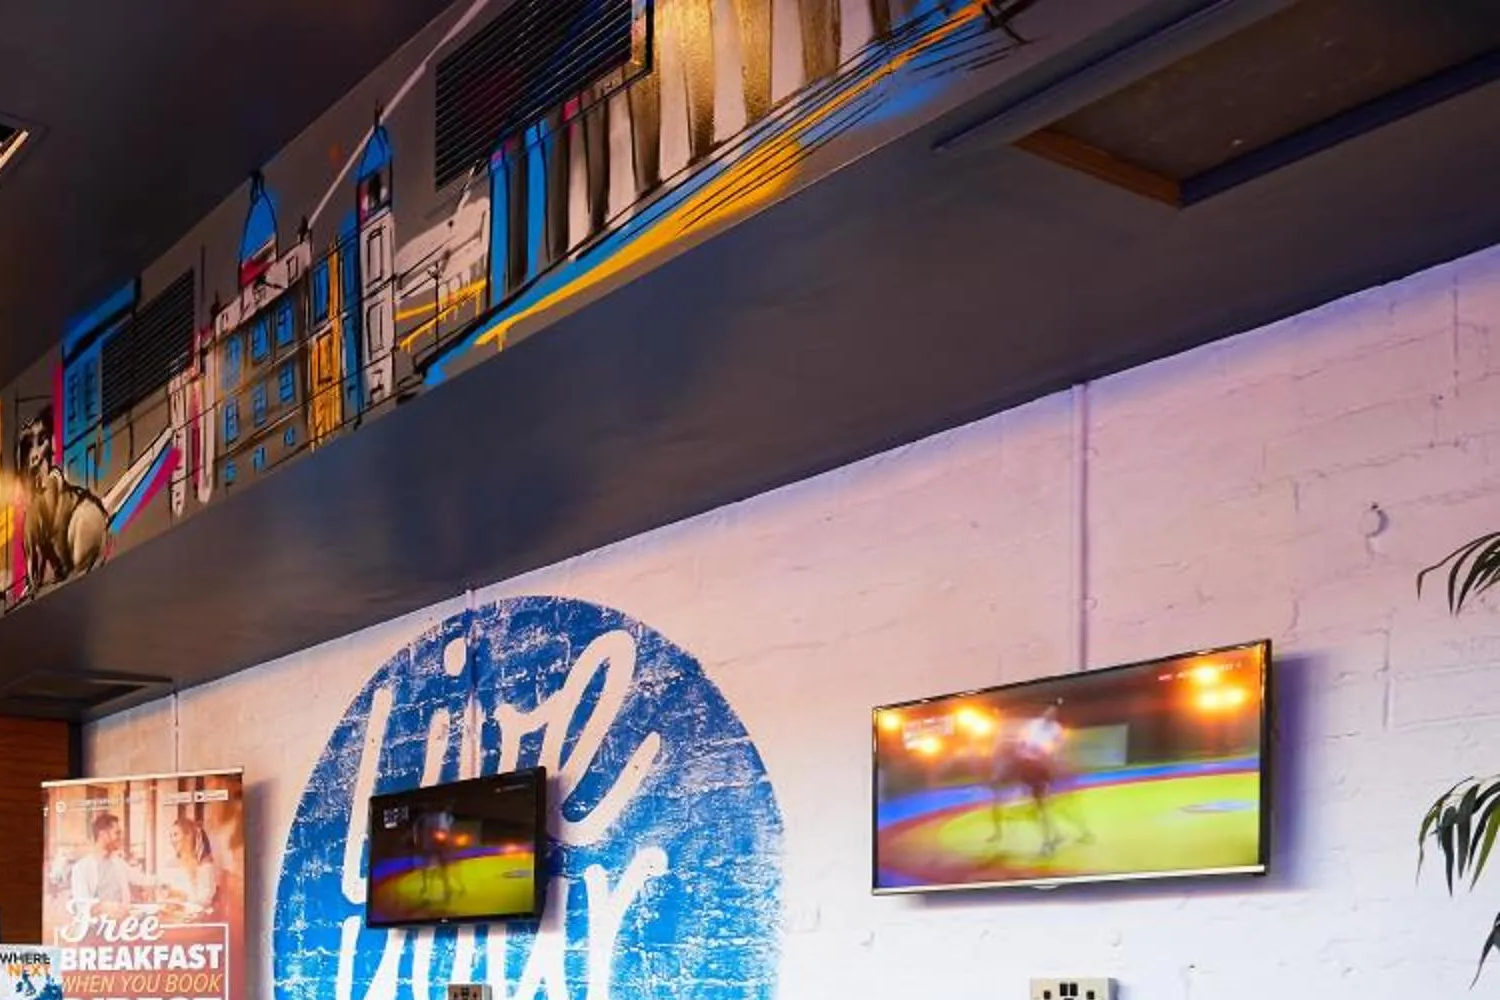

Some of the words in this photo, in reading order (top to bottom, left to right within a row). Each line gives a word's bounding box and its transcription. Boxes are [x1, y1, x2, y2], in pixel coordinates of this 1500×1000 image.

[60, 899, 164, 943] Free
[0, 952, 50, 965] WHERE
[60, 943, 223, 971] BREAKFAST
[63, 974, 115, 993] WHEN
[121, 974, 161, 993] YOU
[165, 972, 223, 993] BOOK
